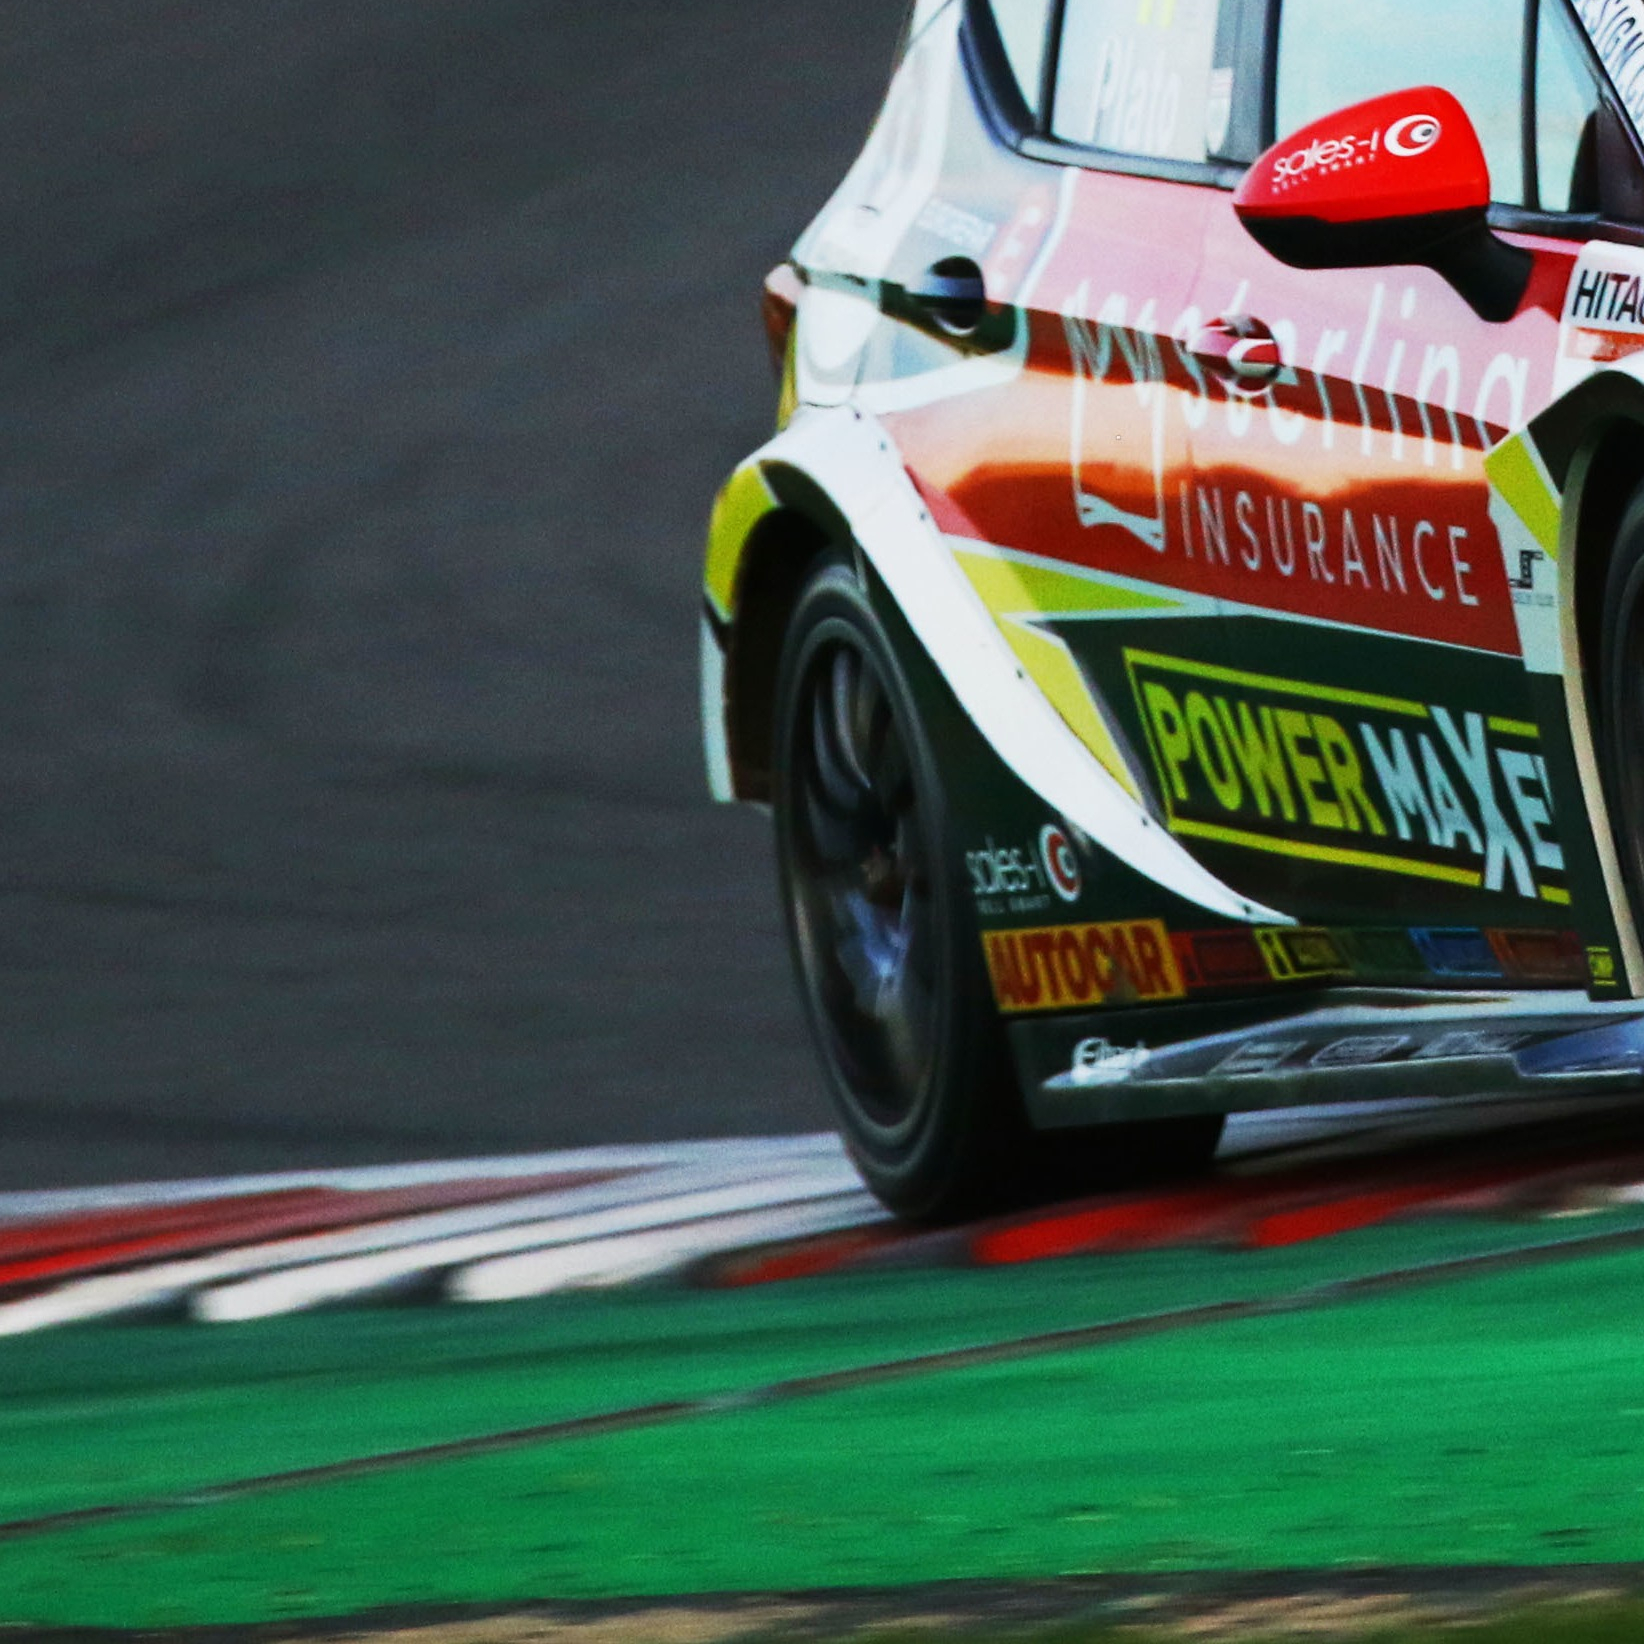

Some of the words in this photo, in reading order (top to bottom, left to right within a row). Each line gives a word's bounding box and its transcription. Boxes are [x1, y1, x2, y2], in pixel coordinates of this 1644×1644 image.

[1178, 479, 1480, 607] INSURANCE
[1142, 681, 1388, 836] POWER
[1358, 704, 1566, 901] MAXE
